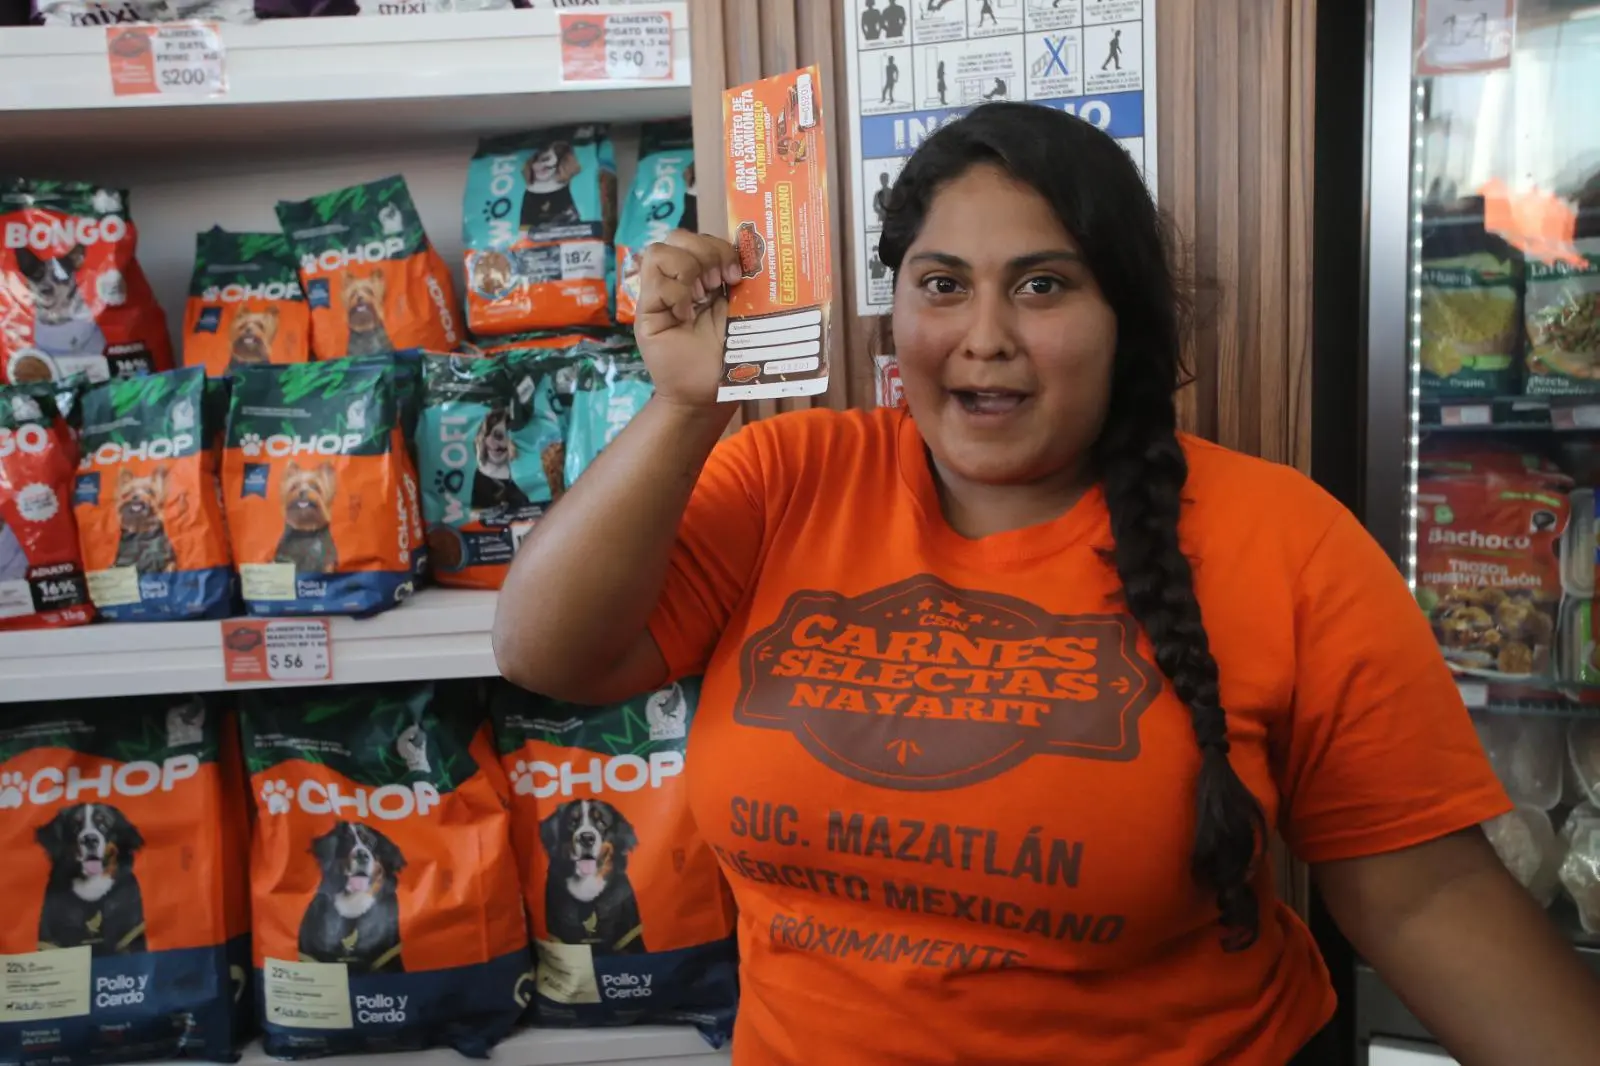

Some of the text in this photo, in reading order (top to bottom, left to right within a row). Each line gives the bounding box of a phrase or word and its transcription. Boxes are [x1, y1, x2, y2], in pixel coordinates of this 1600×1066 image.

[609, 15, 663, 24] ALIMENTO
[162, 68, 205, 86] $200
[731, 97, 743, 111] DE
[754, 100, 765, 140] MODELO
[732, 115, 744, 157] SORTEO
[742, 88, 758, 194] UNA CAMIONETA
[735, 160, 746, 191] GRAN
[5, 214, 127, 250] BONGO
[778, 185, 795, 302] EJÉRCITO MEXICANO
[317, 237, 405, 271] CHOP
[95, 433, 194, 465] CHOP
[265, 434, 362, 456] CHOP
[790, 613, 1099, 671] CARNES
[283, 653, 304, 670] 56
[770, 648, 1099, 702] SELECTAS
[788, 682, 1052, 728] NAYARIT
[28, 753, 199, 805] CHOP
[527, 750, 684, 798] CHOP
[297, 779, 441, 820] CHOP
[730, 796, 1085, 888] SUC. MAZATLÁN
[884, 880, 1127, 944] MEXICANO
[769, 912, 1029, 971] PRÓXIMAMENTE
[96, 973, 150, 992] Pollo y
[601, 974, 640, 987] Pollo
[604, 986, 653, 998] Cerdo
[95, 991, 145, 1008] Cerdo
[356, 994, 409, 1010] Pollo y
[357, 1009, 407, 1023] Cerdo
